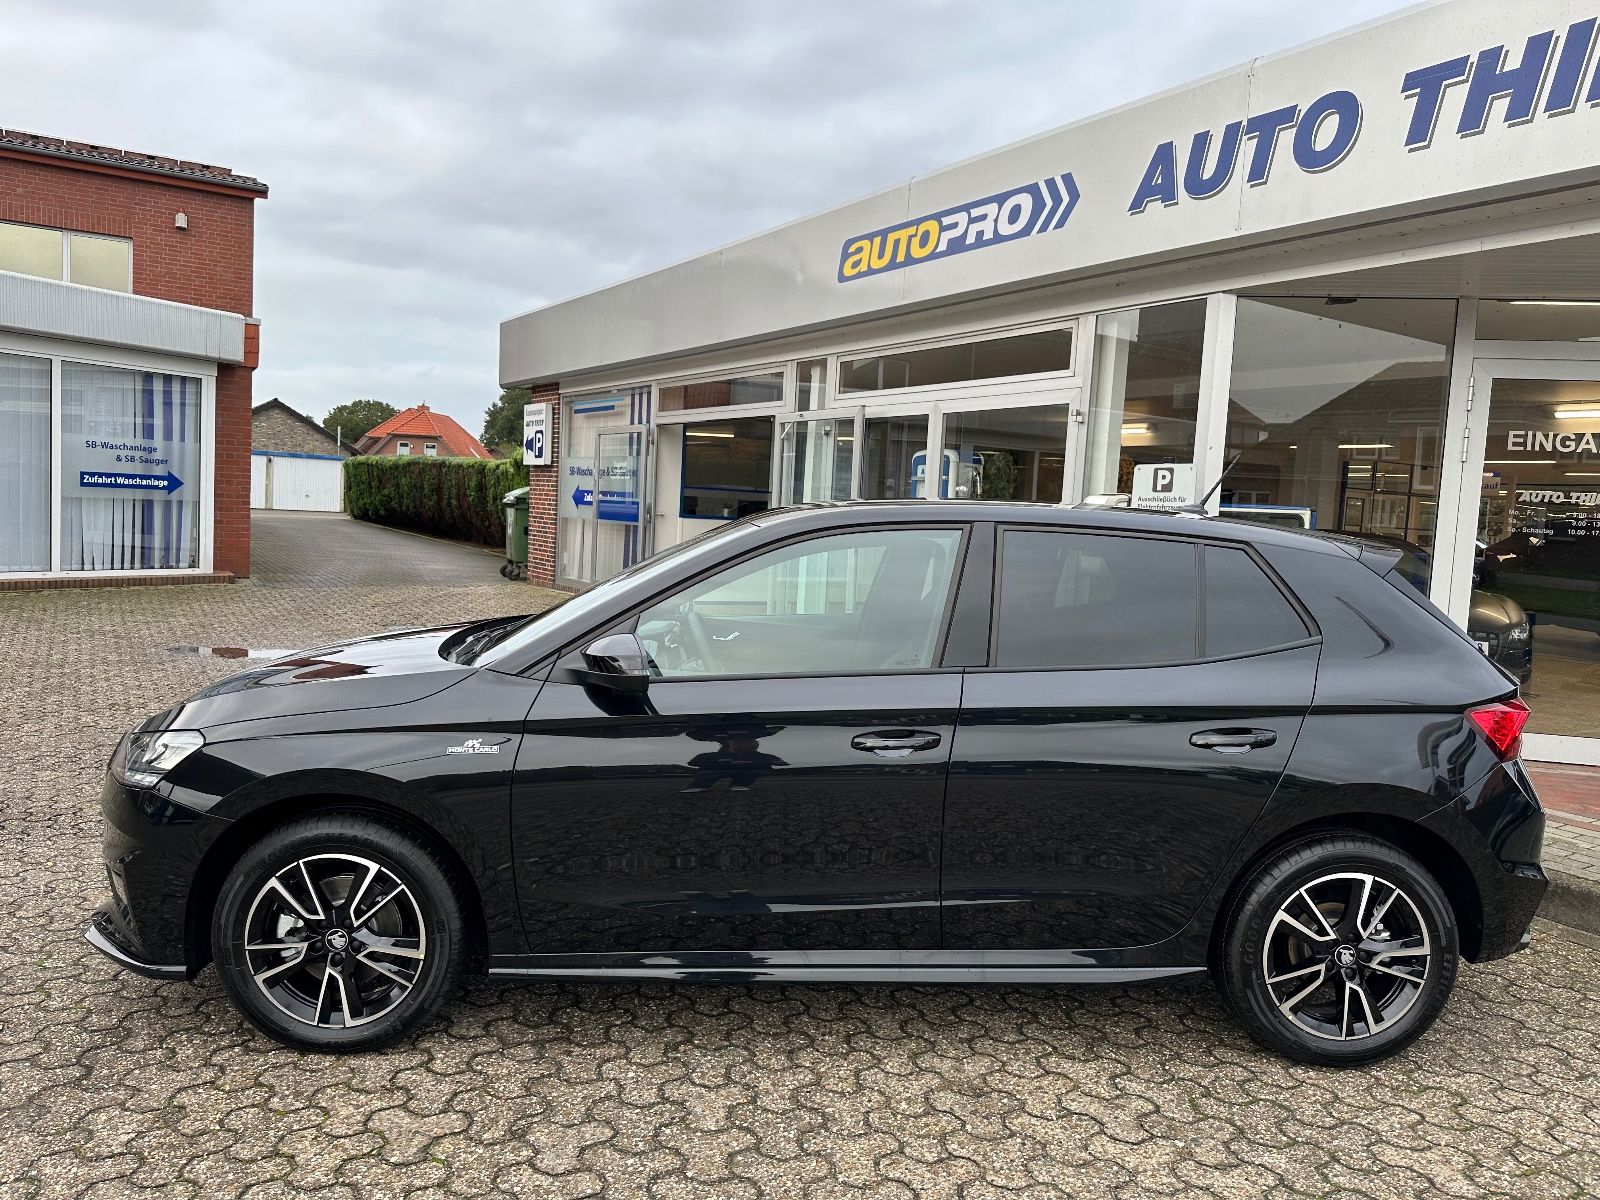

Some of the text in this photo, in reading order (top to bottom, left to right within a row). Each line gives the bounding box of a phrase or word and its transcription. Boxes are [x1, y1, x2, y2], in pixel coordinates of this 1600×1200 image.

[1127, 16, 1600, 216] AUTO THI
[85, 440, 158, 454] SB-Waschanlage
[1507, 430, 1600, 454] EINGA
[124, 454, 169, 466] SB-Sauger
[83, 475, 169, 488] Zufahrt Waschanlage
[1156, 469, 1172, 491] P
[1137, 495, 1187, 503] Ausschließlich für
[1518, 491, 1564, 504] AUTO
[1521, 526, 1554, 535] Schautag
